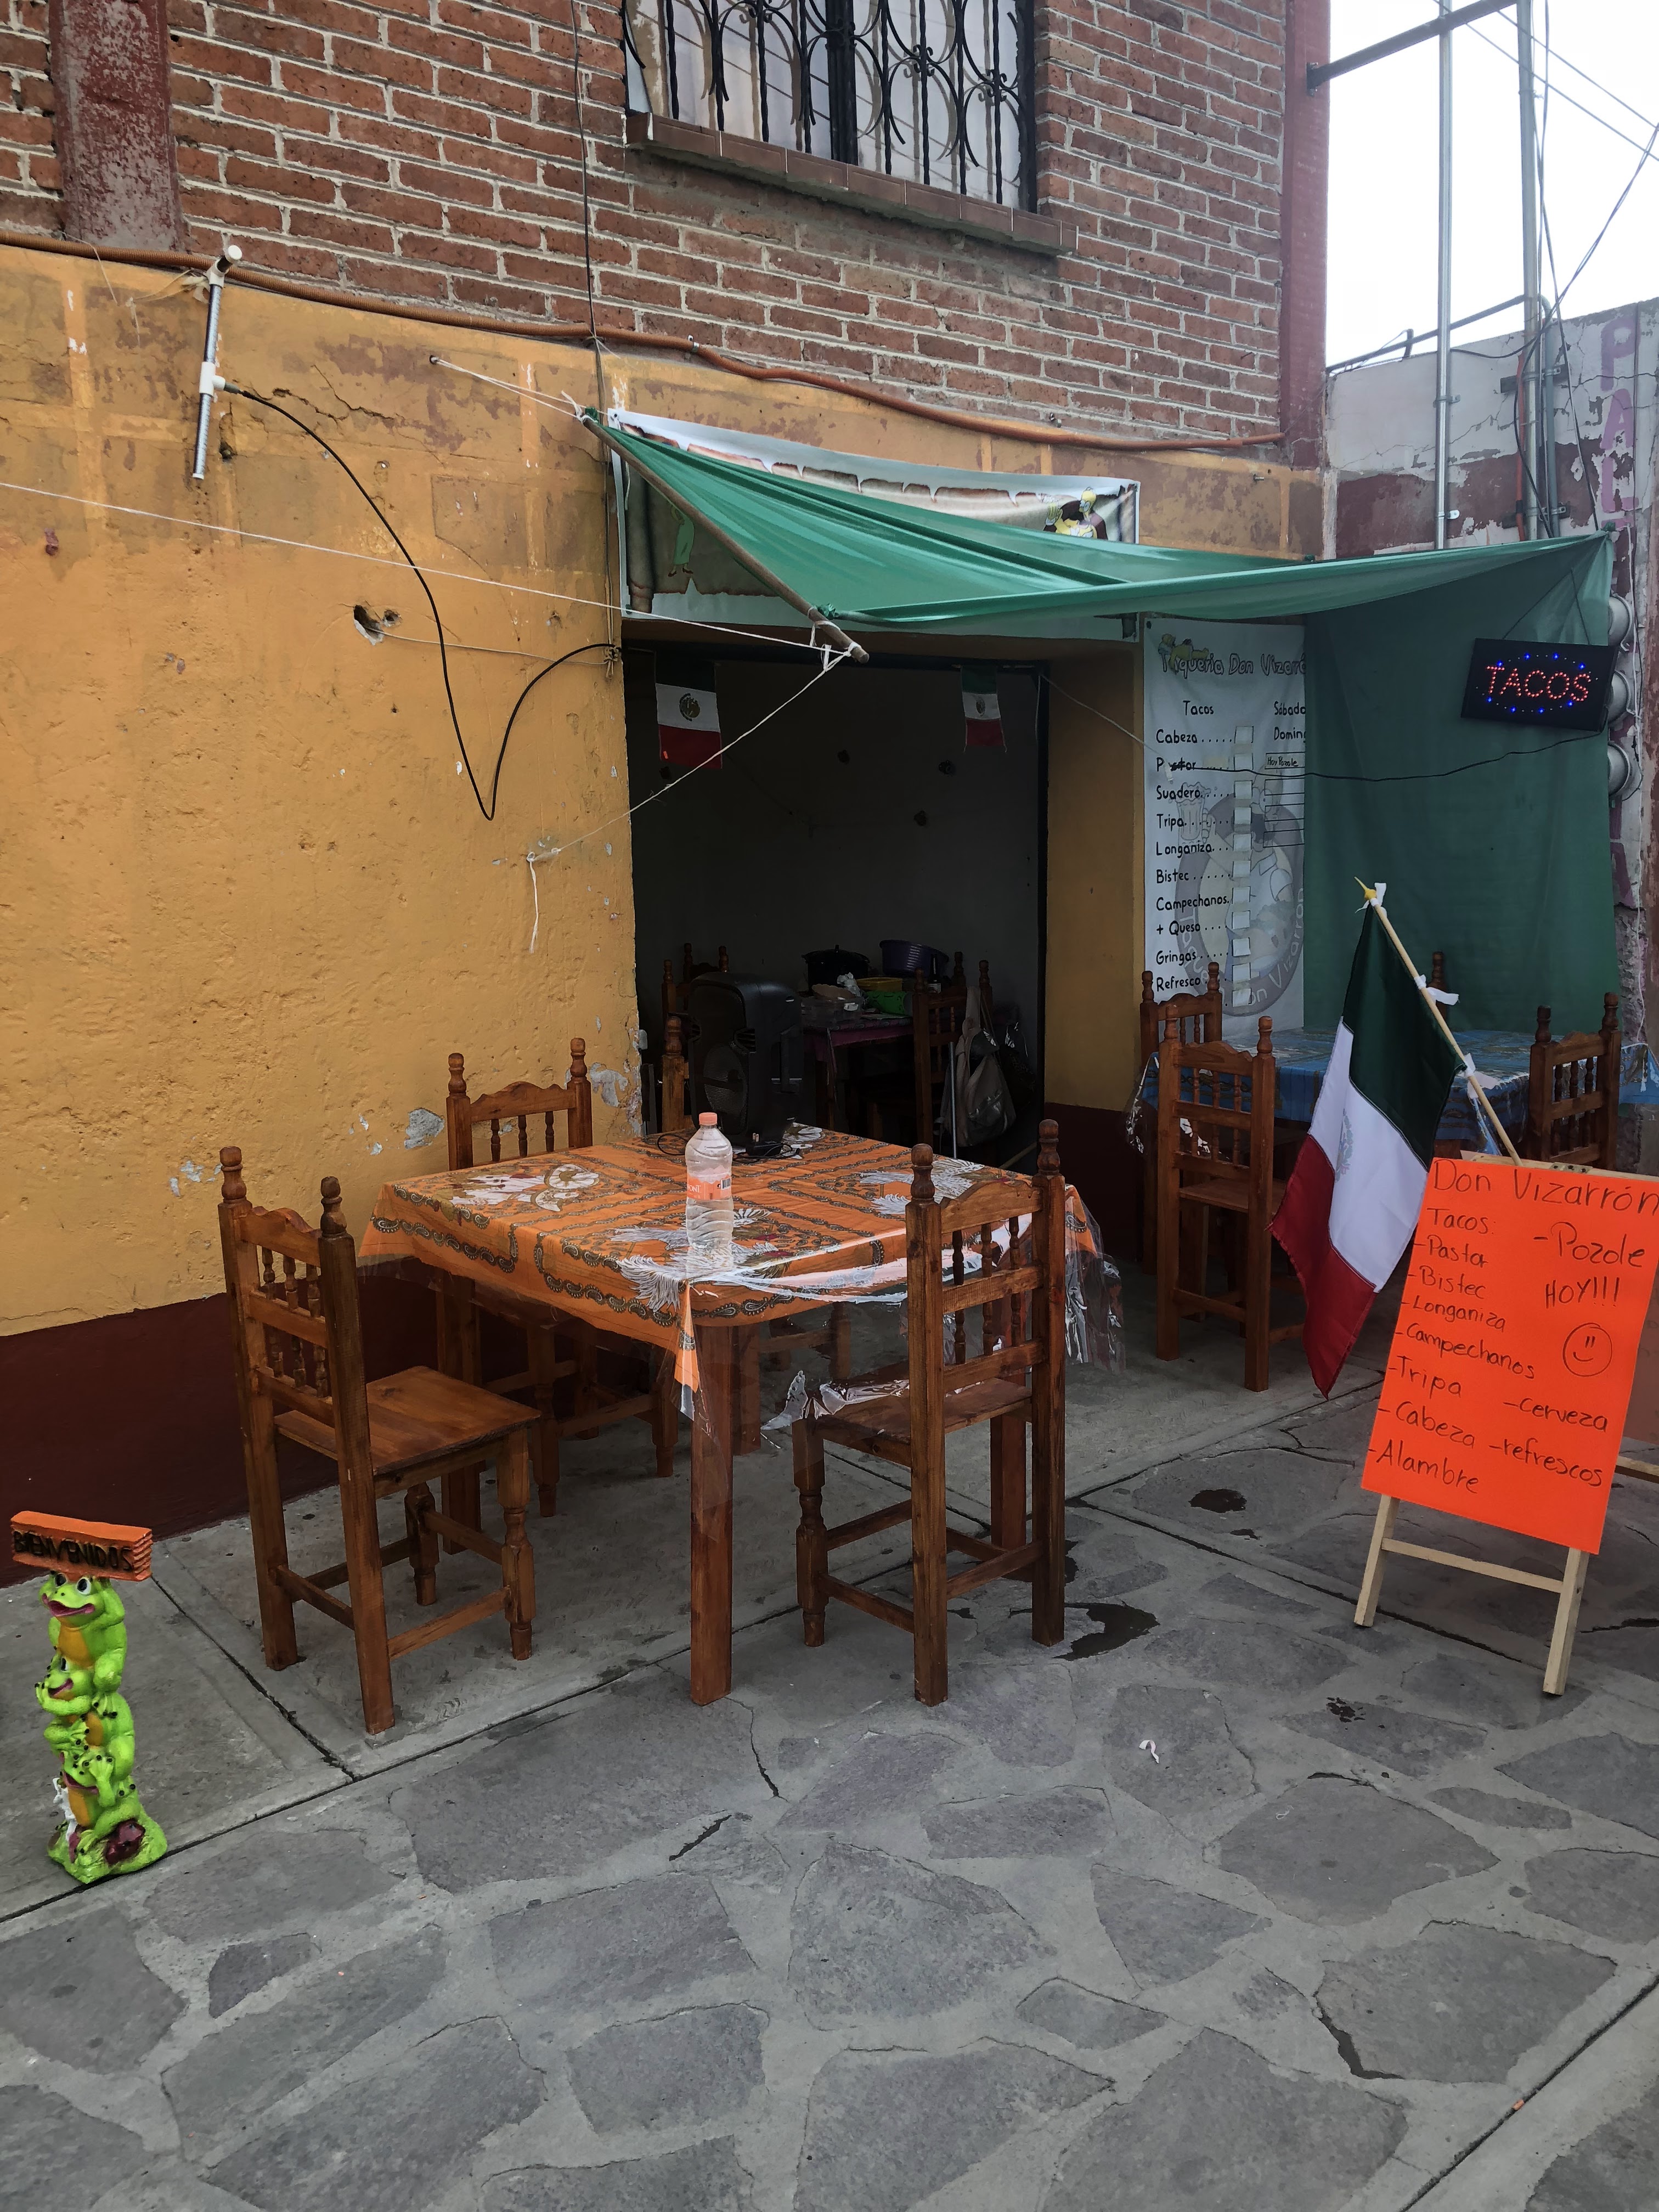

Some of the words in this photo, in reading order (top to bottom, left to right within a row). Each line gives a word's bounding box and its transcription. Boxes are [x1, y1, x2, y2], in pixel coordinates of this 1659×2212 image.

[1228, 653, 1254, 675] Don
[1486, 665, 1591, 702] TACOS
[1183, 700, 1214, 715] Tacos
[1156, 729, 1198, 743] Cabeza
[1156, 757, 1196, 772] Pstor
[1267, 757, 1278, 766] Hoy
[1278, 756, 1299, 766] Pozole
[1156, 786, 1200, 800] Suadero
[1156, 814, 1184, 829] Tripa
[1156, 842, 1212, 858] Longaniza
[1156, 870, 1189, 883] Bistec
[1169, 921, 1200, 935] Queso
[1156, 950, 1196, 966] Gringas
[1156, 977, 1200, 992] Refresco
[1433, 1159, 1491, 1193] Don
[1515, 1169, 1659, 1216] Vizarrón
